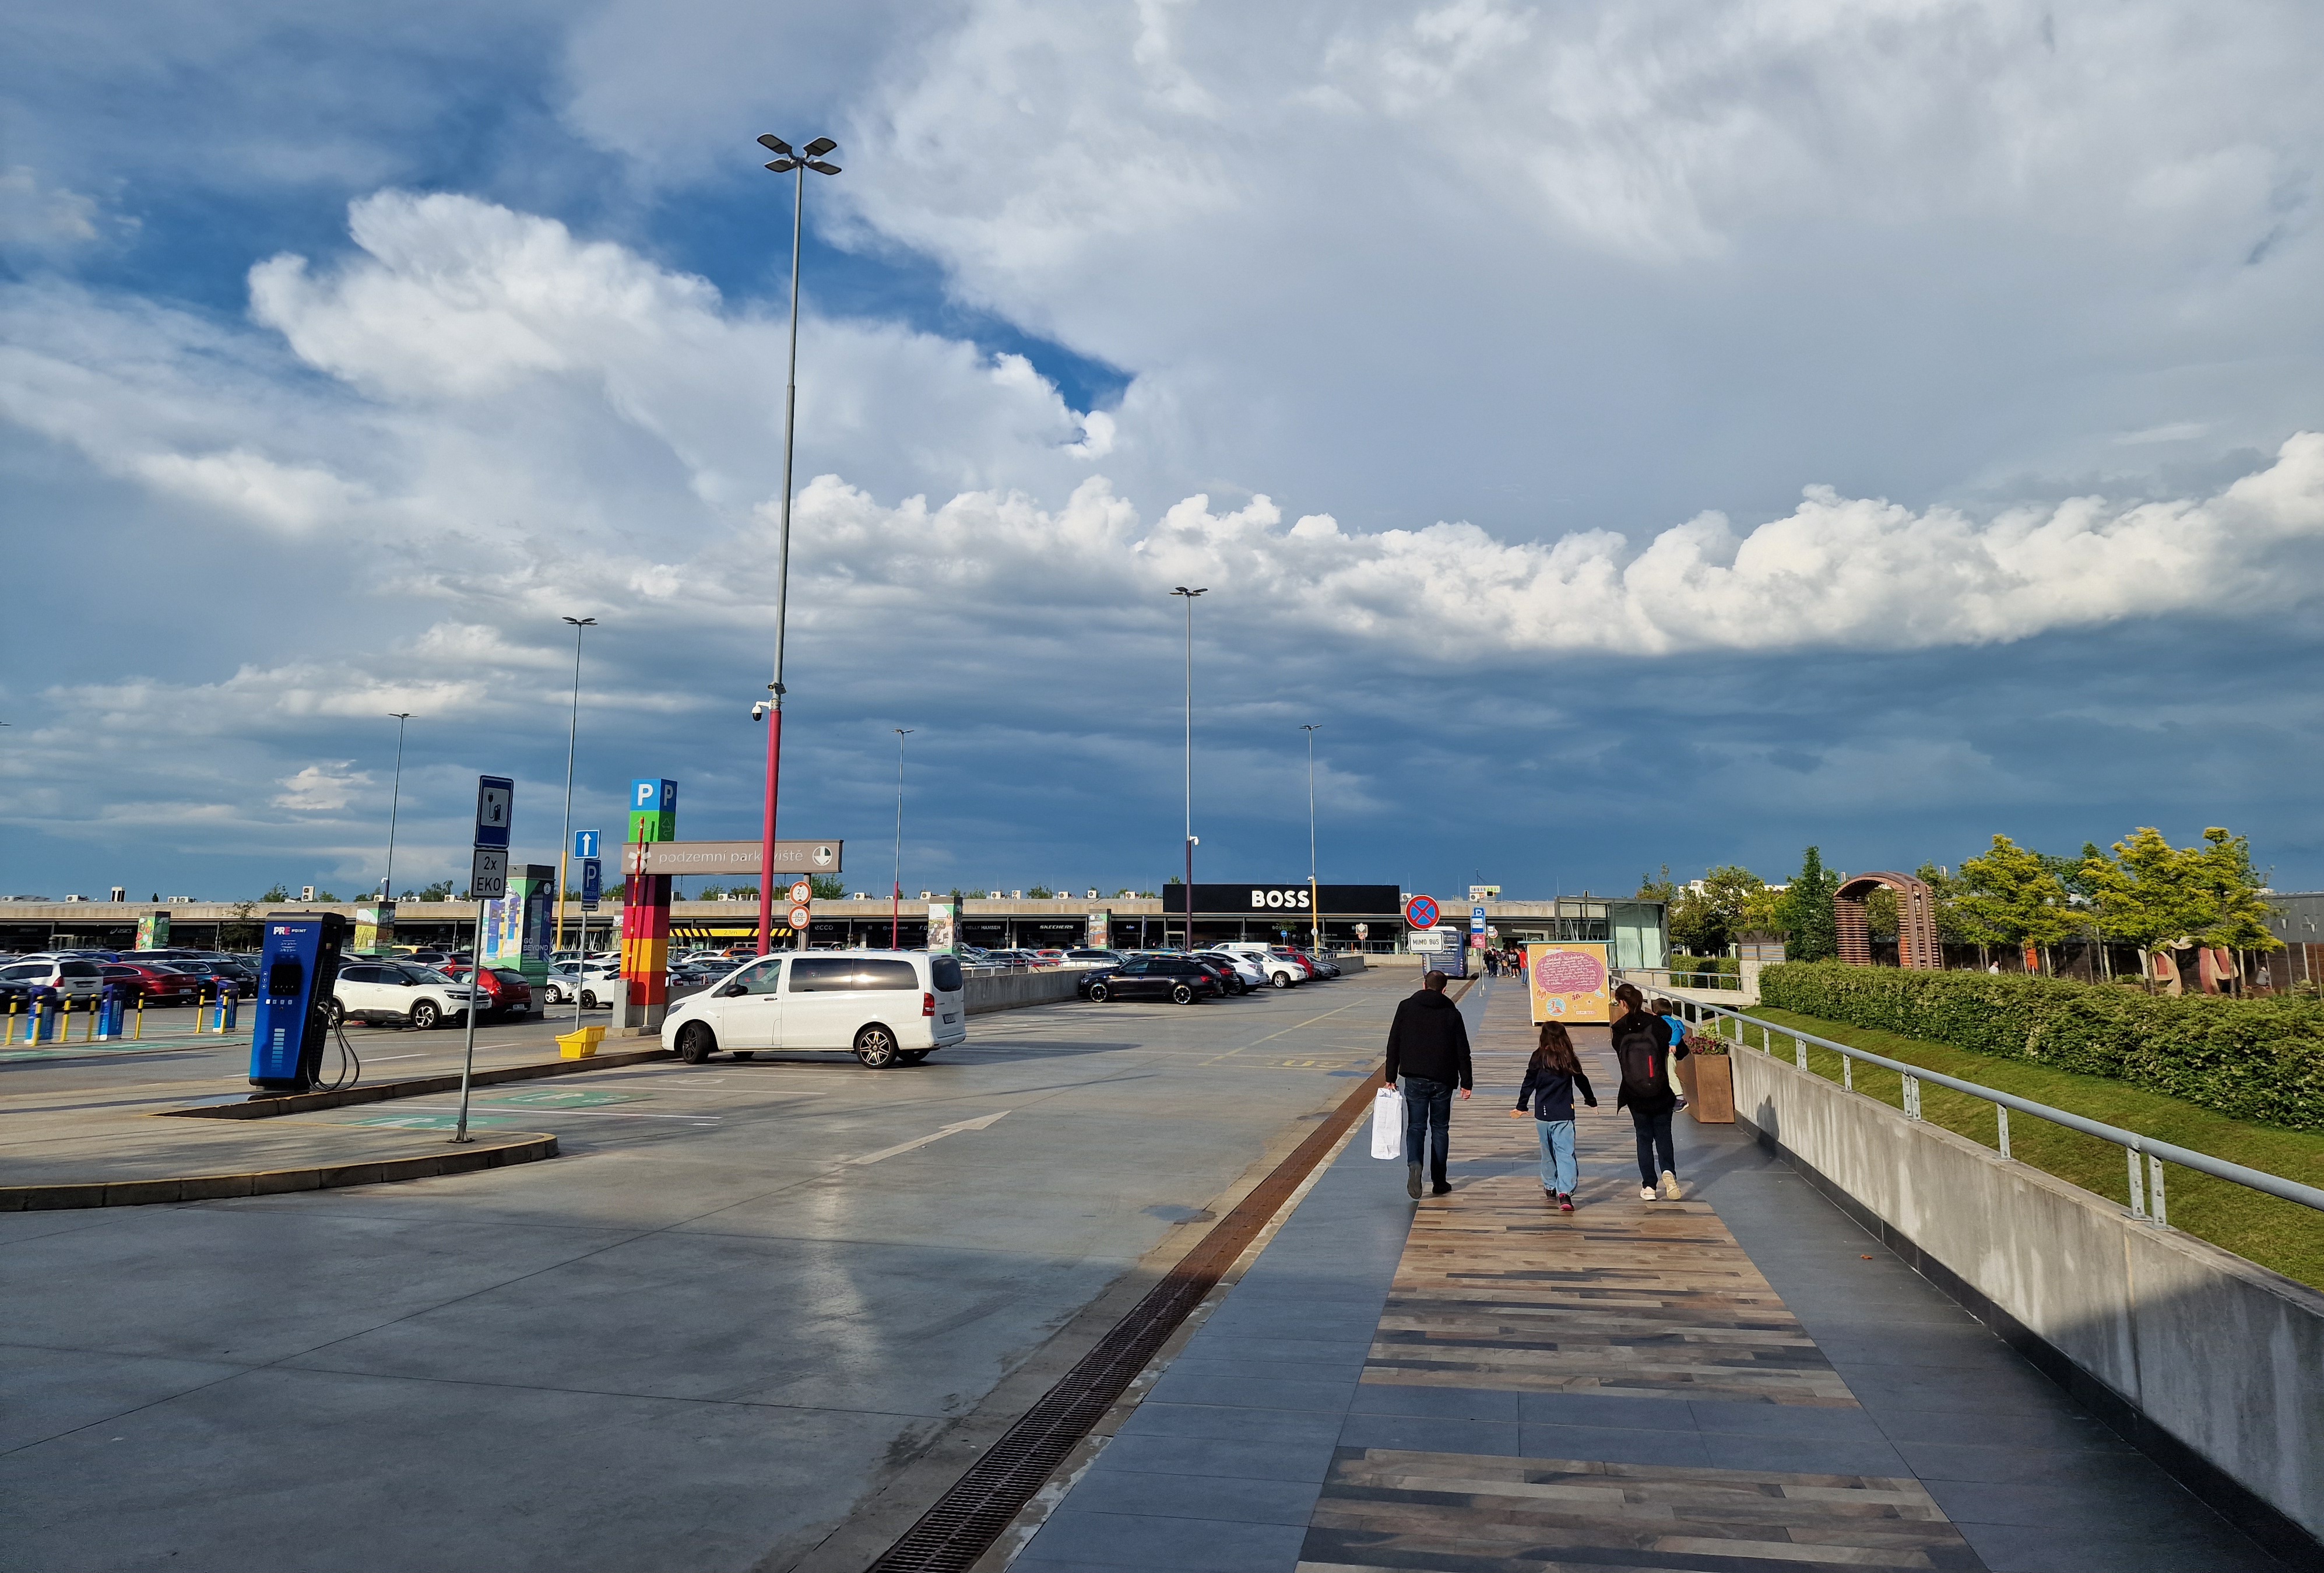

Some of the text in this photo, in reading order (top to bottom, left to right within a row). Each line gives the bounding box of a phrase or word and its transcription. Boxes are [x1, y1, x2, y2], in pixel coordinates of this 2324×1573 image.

[637, 784, 653, 806] P
[663, 784, 673, 806] P
[483, 856, 497, 870] 2x
[659, 849, 803, 865] podzemní parkviště
[477, 877, 501, 891] EKO
[586, 865, 597, 888] P
[1251, 890, 1310, 908] BOSS
[273, 926, 291, 935] PRE
